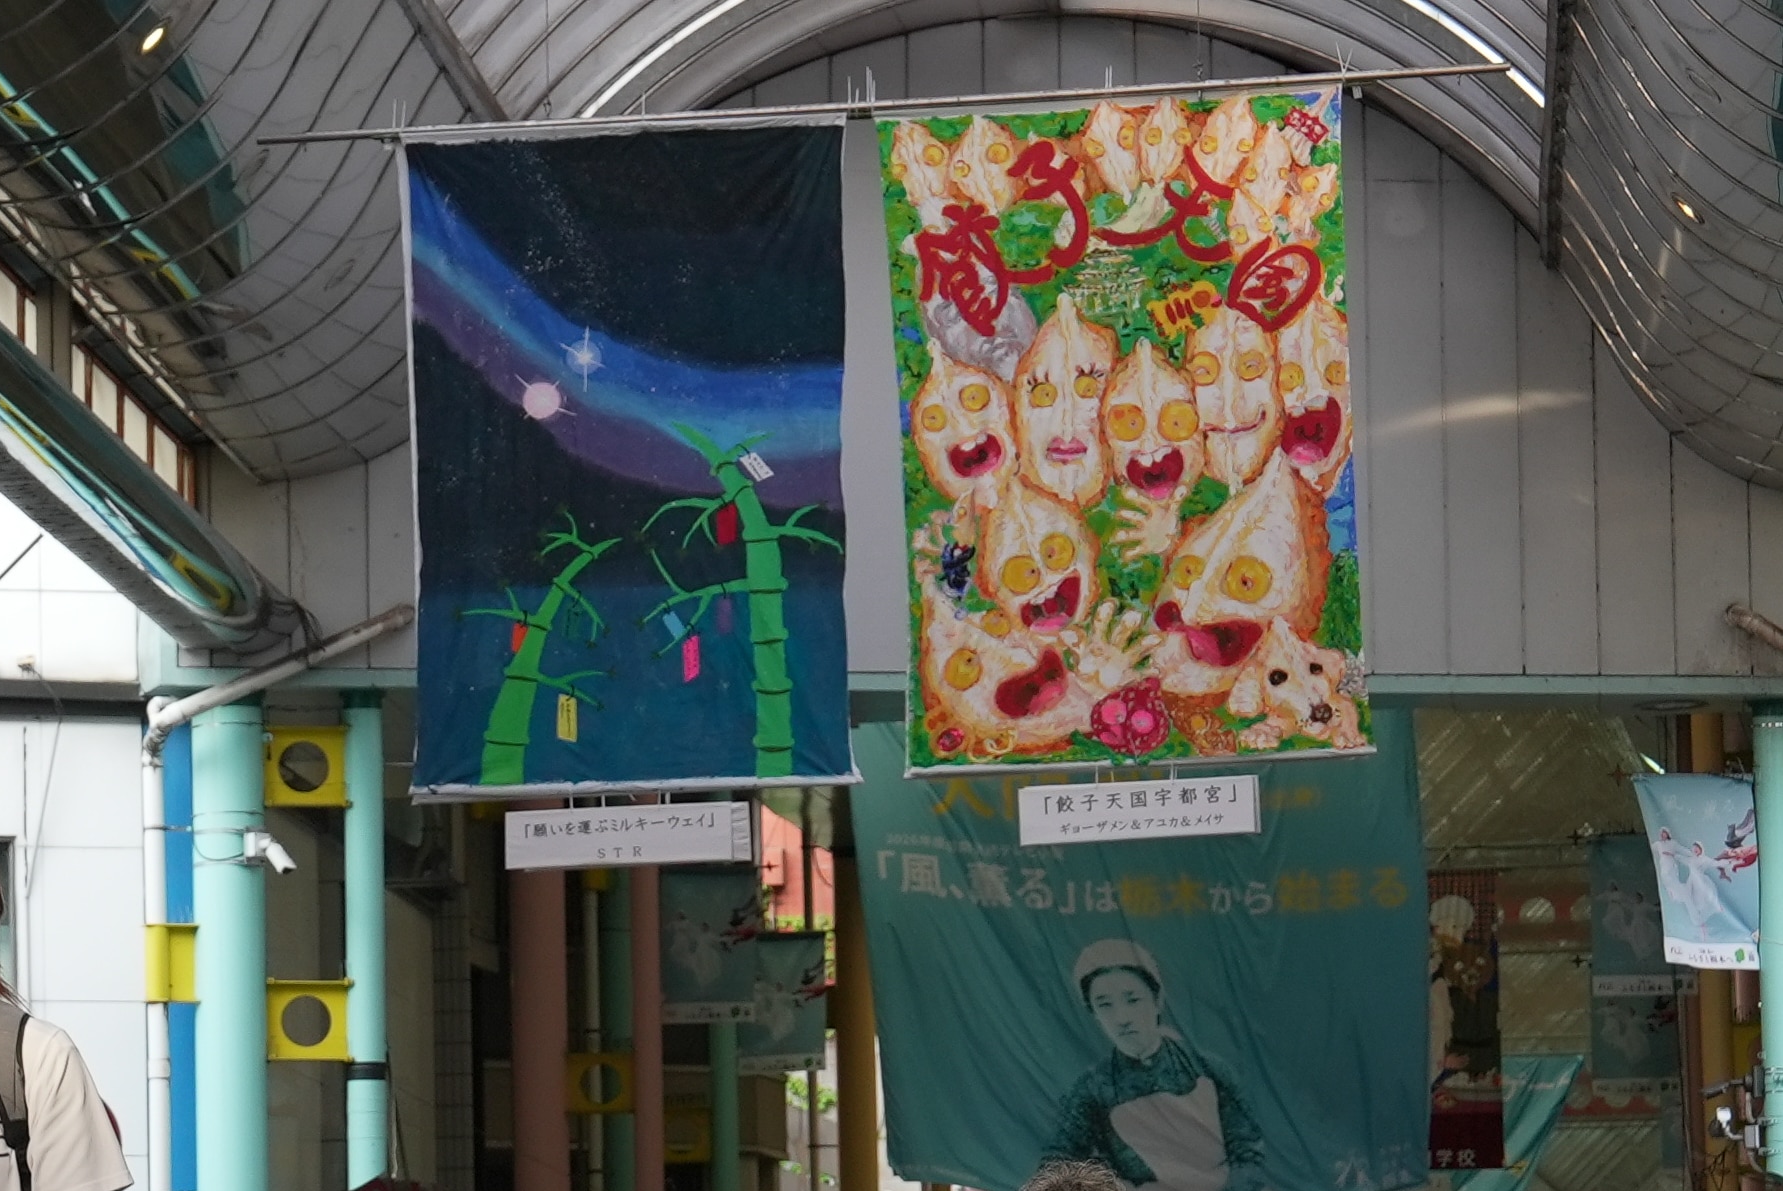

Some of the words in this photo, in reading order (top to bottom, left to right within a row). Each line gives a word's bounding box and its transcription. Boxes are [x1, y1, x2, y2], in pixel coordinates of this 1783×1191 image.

[1042, 784, 1239, 816] 「餃子天国宇都宮」
[523, 812, 716, 839] 「願いを運ぶミルキーウェイ」
